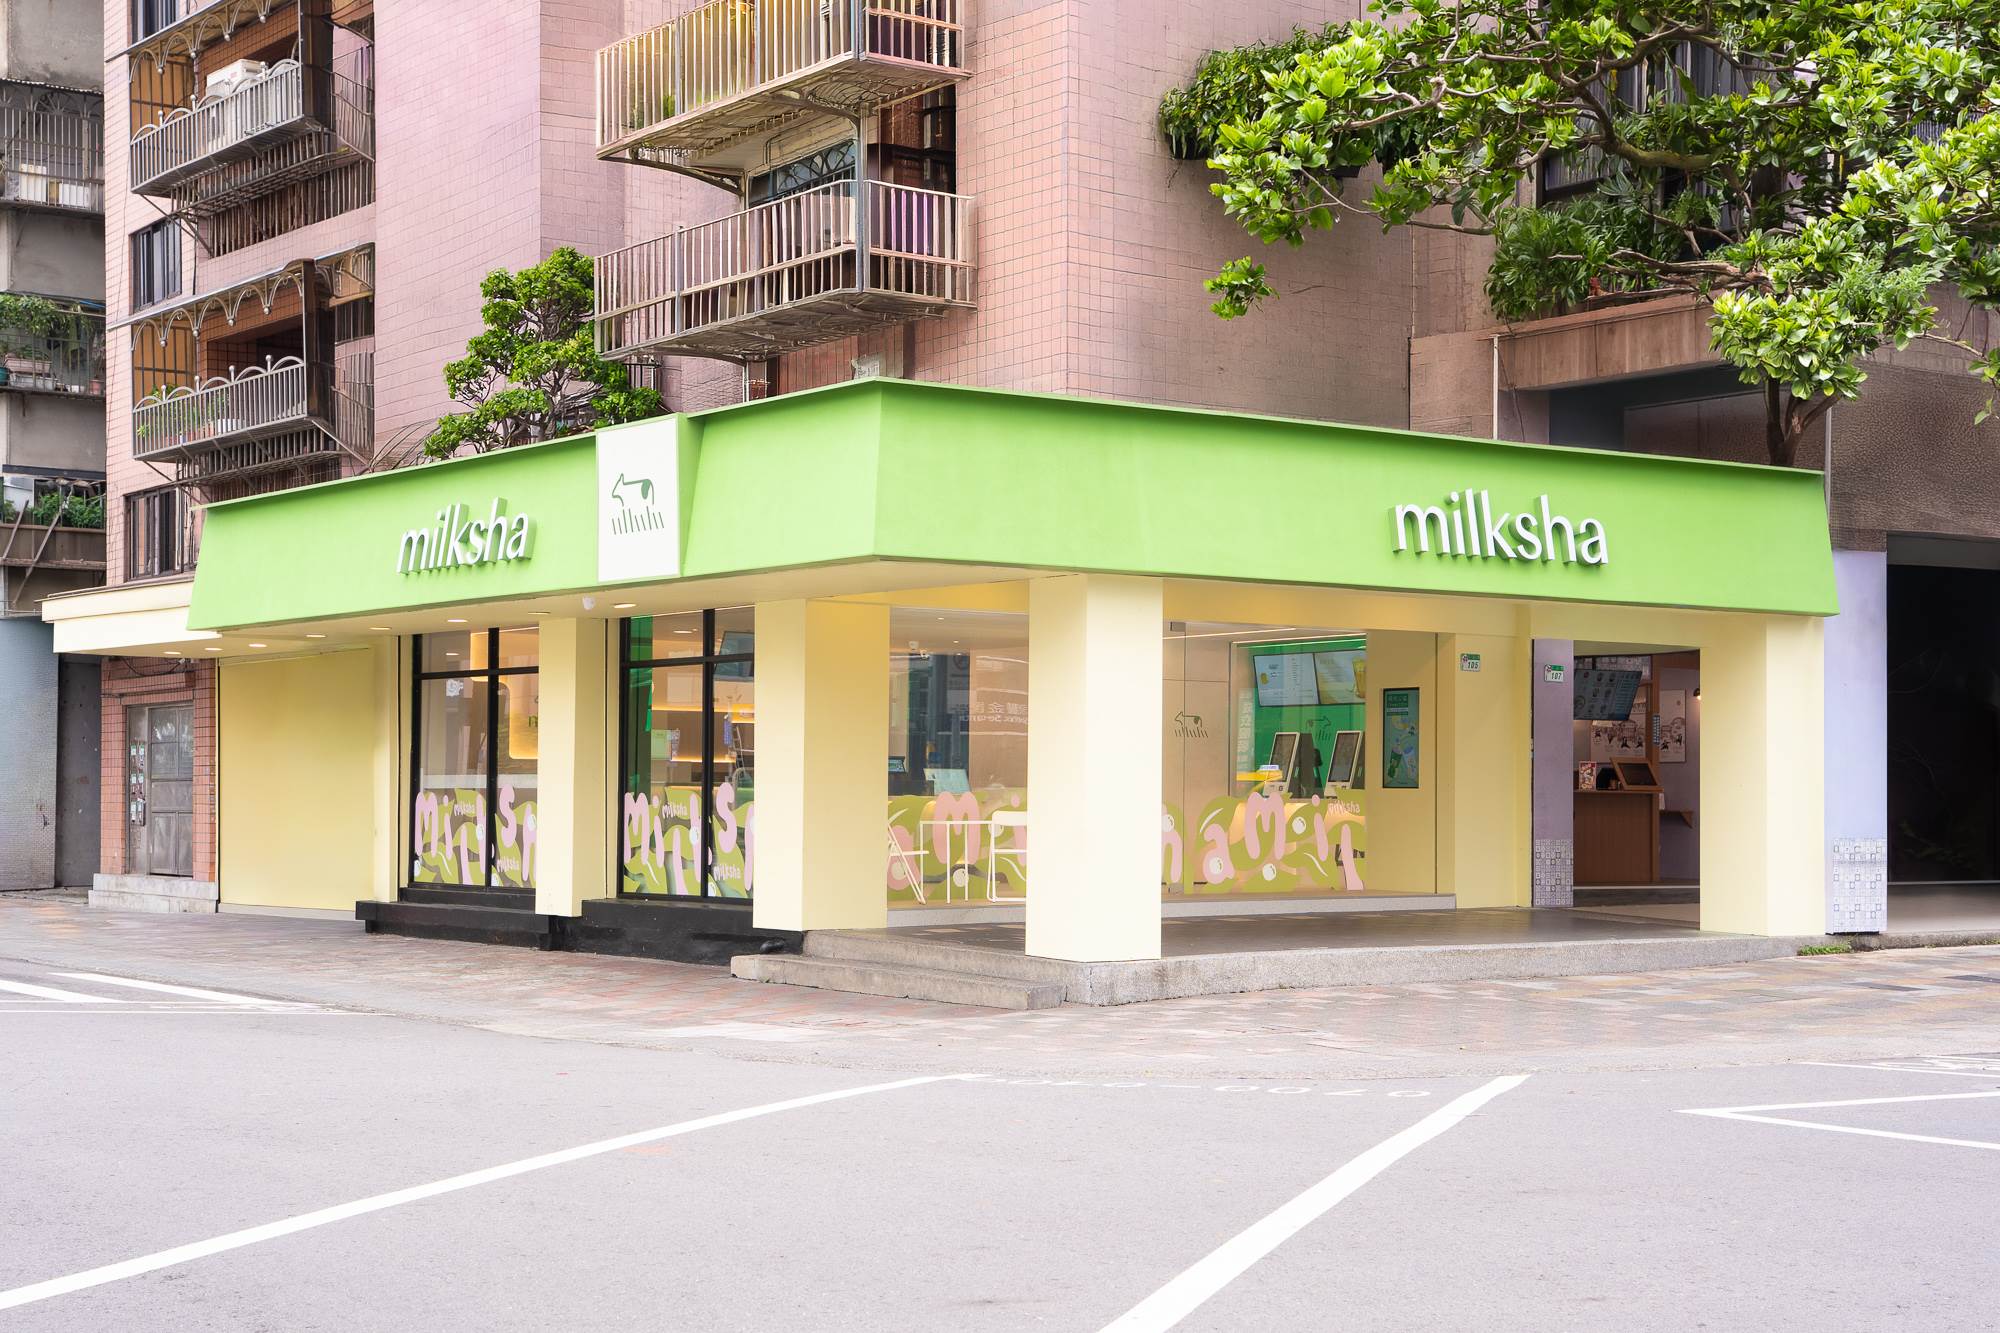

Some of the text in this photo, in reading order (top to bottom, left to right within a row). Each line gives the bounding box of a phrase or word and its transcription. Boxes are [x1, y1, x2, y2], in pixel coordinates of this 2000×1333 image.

[397, 497, 534, 575] milksha
[1392, 488, 1609, 565] milksha
[1467, 661, 1479, 669] 105
[1551, 671, 1562, 680] 107
